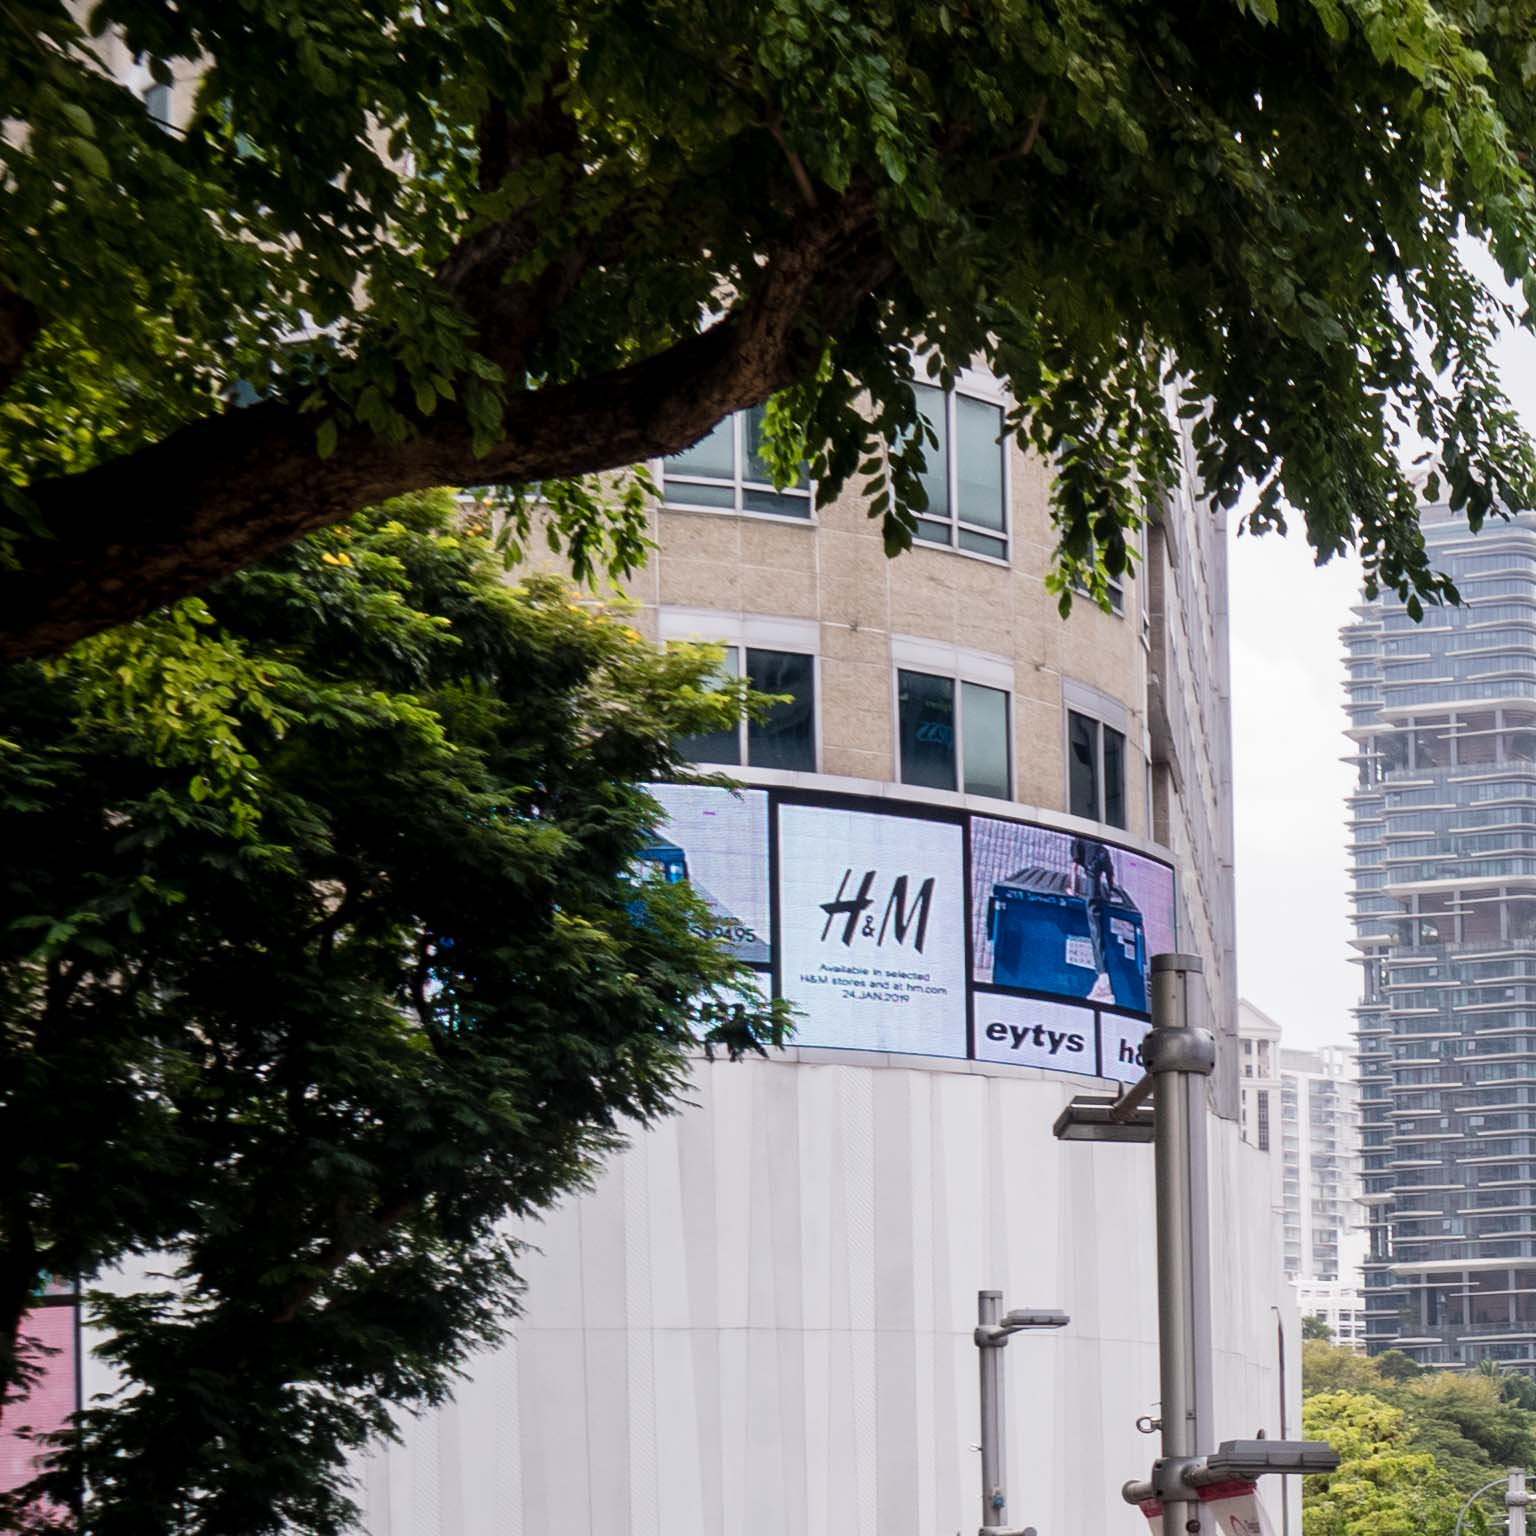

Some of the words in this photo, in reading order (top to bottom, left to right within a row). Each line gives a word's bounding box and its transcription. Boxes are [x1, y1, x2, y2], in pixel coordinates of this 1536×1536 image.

[818, 868, 936, 954] H&M
[800, 974, 829, 985] H&M
[832, 978, 867, 988] stores
[870, 981, 889, 990] and
[893, 982, 903, 991] at
[906, 984, 948, 995] hm.com
[820, 963, 870, 976] Available
[886, 970, 931, 982] selected
[986, 1022, 1085, 1055] eytys
[1119, 1038, 1145, 1066] h&
